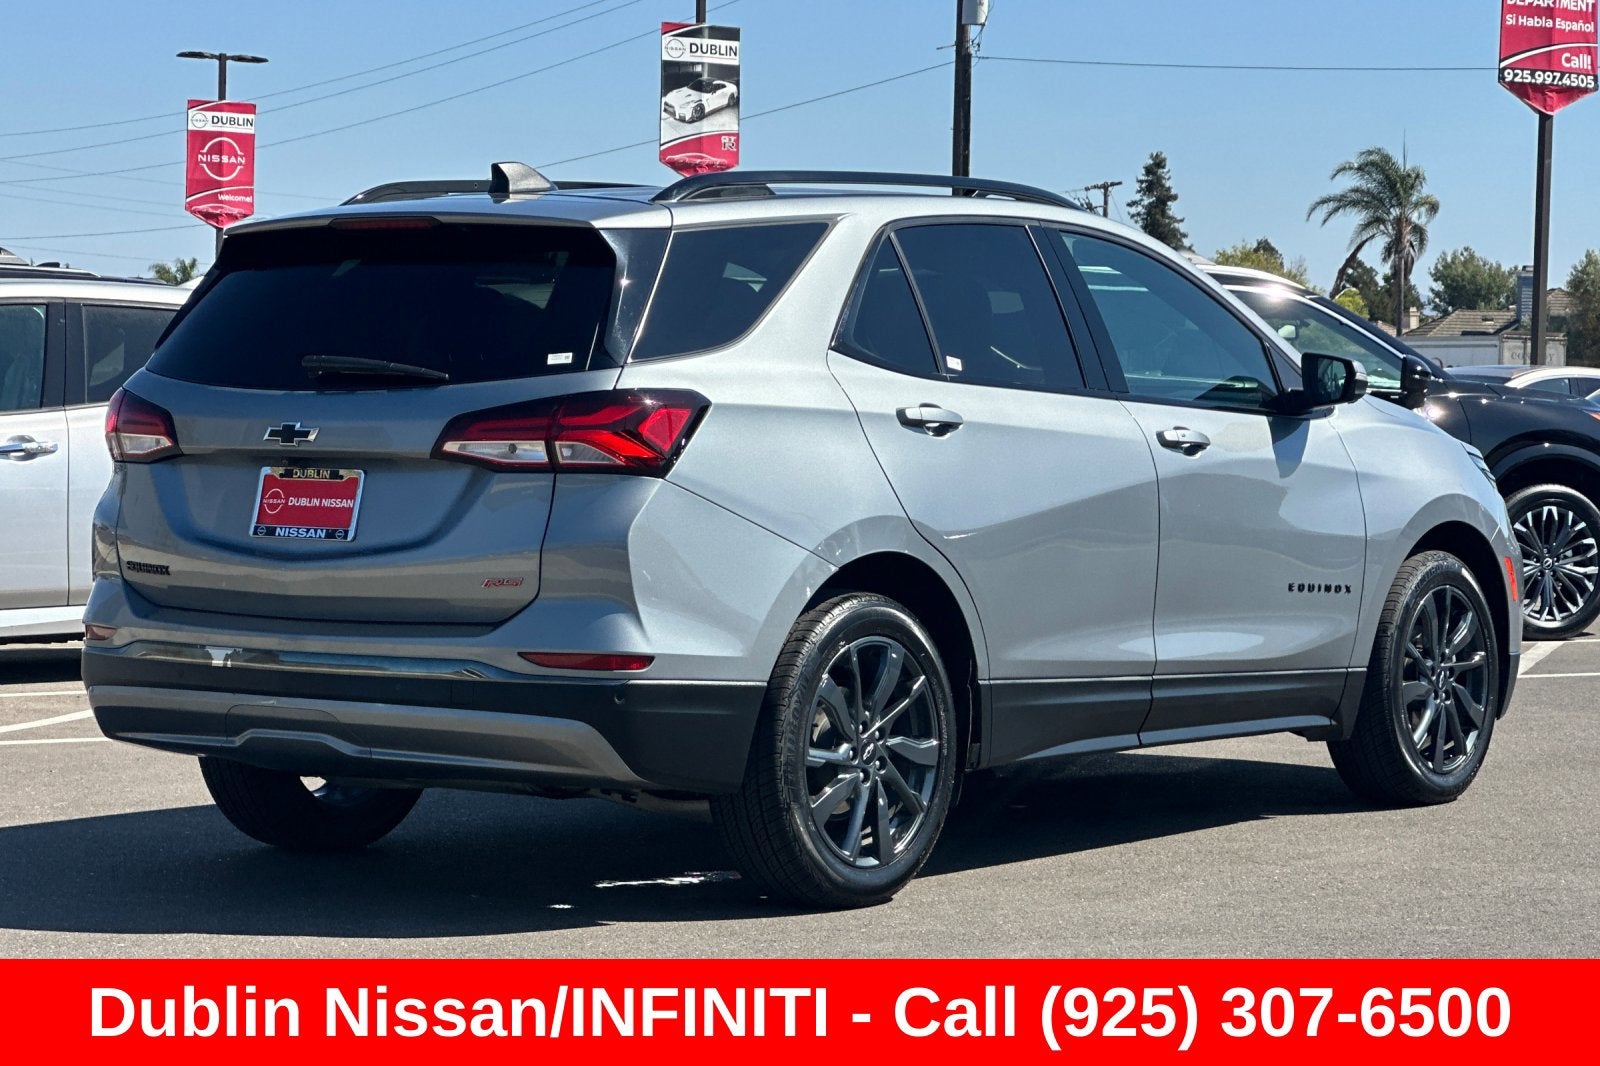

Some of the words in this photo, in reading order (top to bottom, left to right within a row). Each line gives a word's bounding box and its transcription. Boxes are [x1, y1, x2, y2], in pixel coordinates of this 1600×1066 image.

[1505, 14, 1516, 25] Si
[1518, 15, 1553, 28] Habla
[1555, 18, 1594, 32] Español
[689, 42, 738, 57] DUBLIN
[1561, 53, 1592, 70] Call!
[1504, 69, 1595, 88] 925.997.4505
[211, 115, 254, 128] DUBLIN
[198, 154, 246, 164] NISSAN
[218, 193, 253, 203] Welcome!
[292, 468, 331, 479] DUBLIN
[288, 497, 320, 507] DUBLIN
[321, 498, 354, 508] NISSAN
[275, 527, 326, 538] NISSAN
[1288, 582, 1352, 594] EQUINOX
